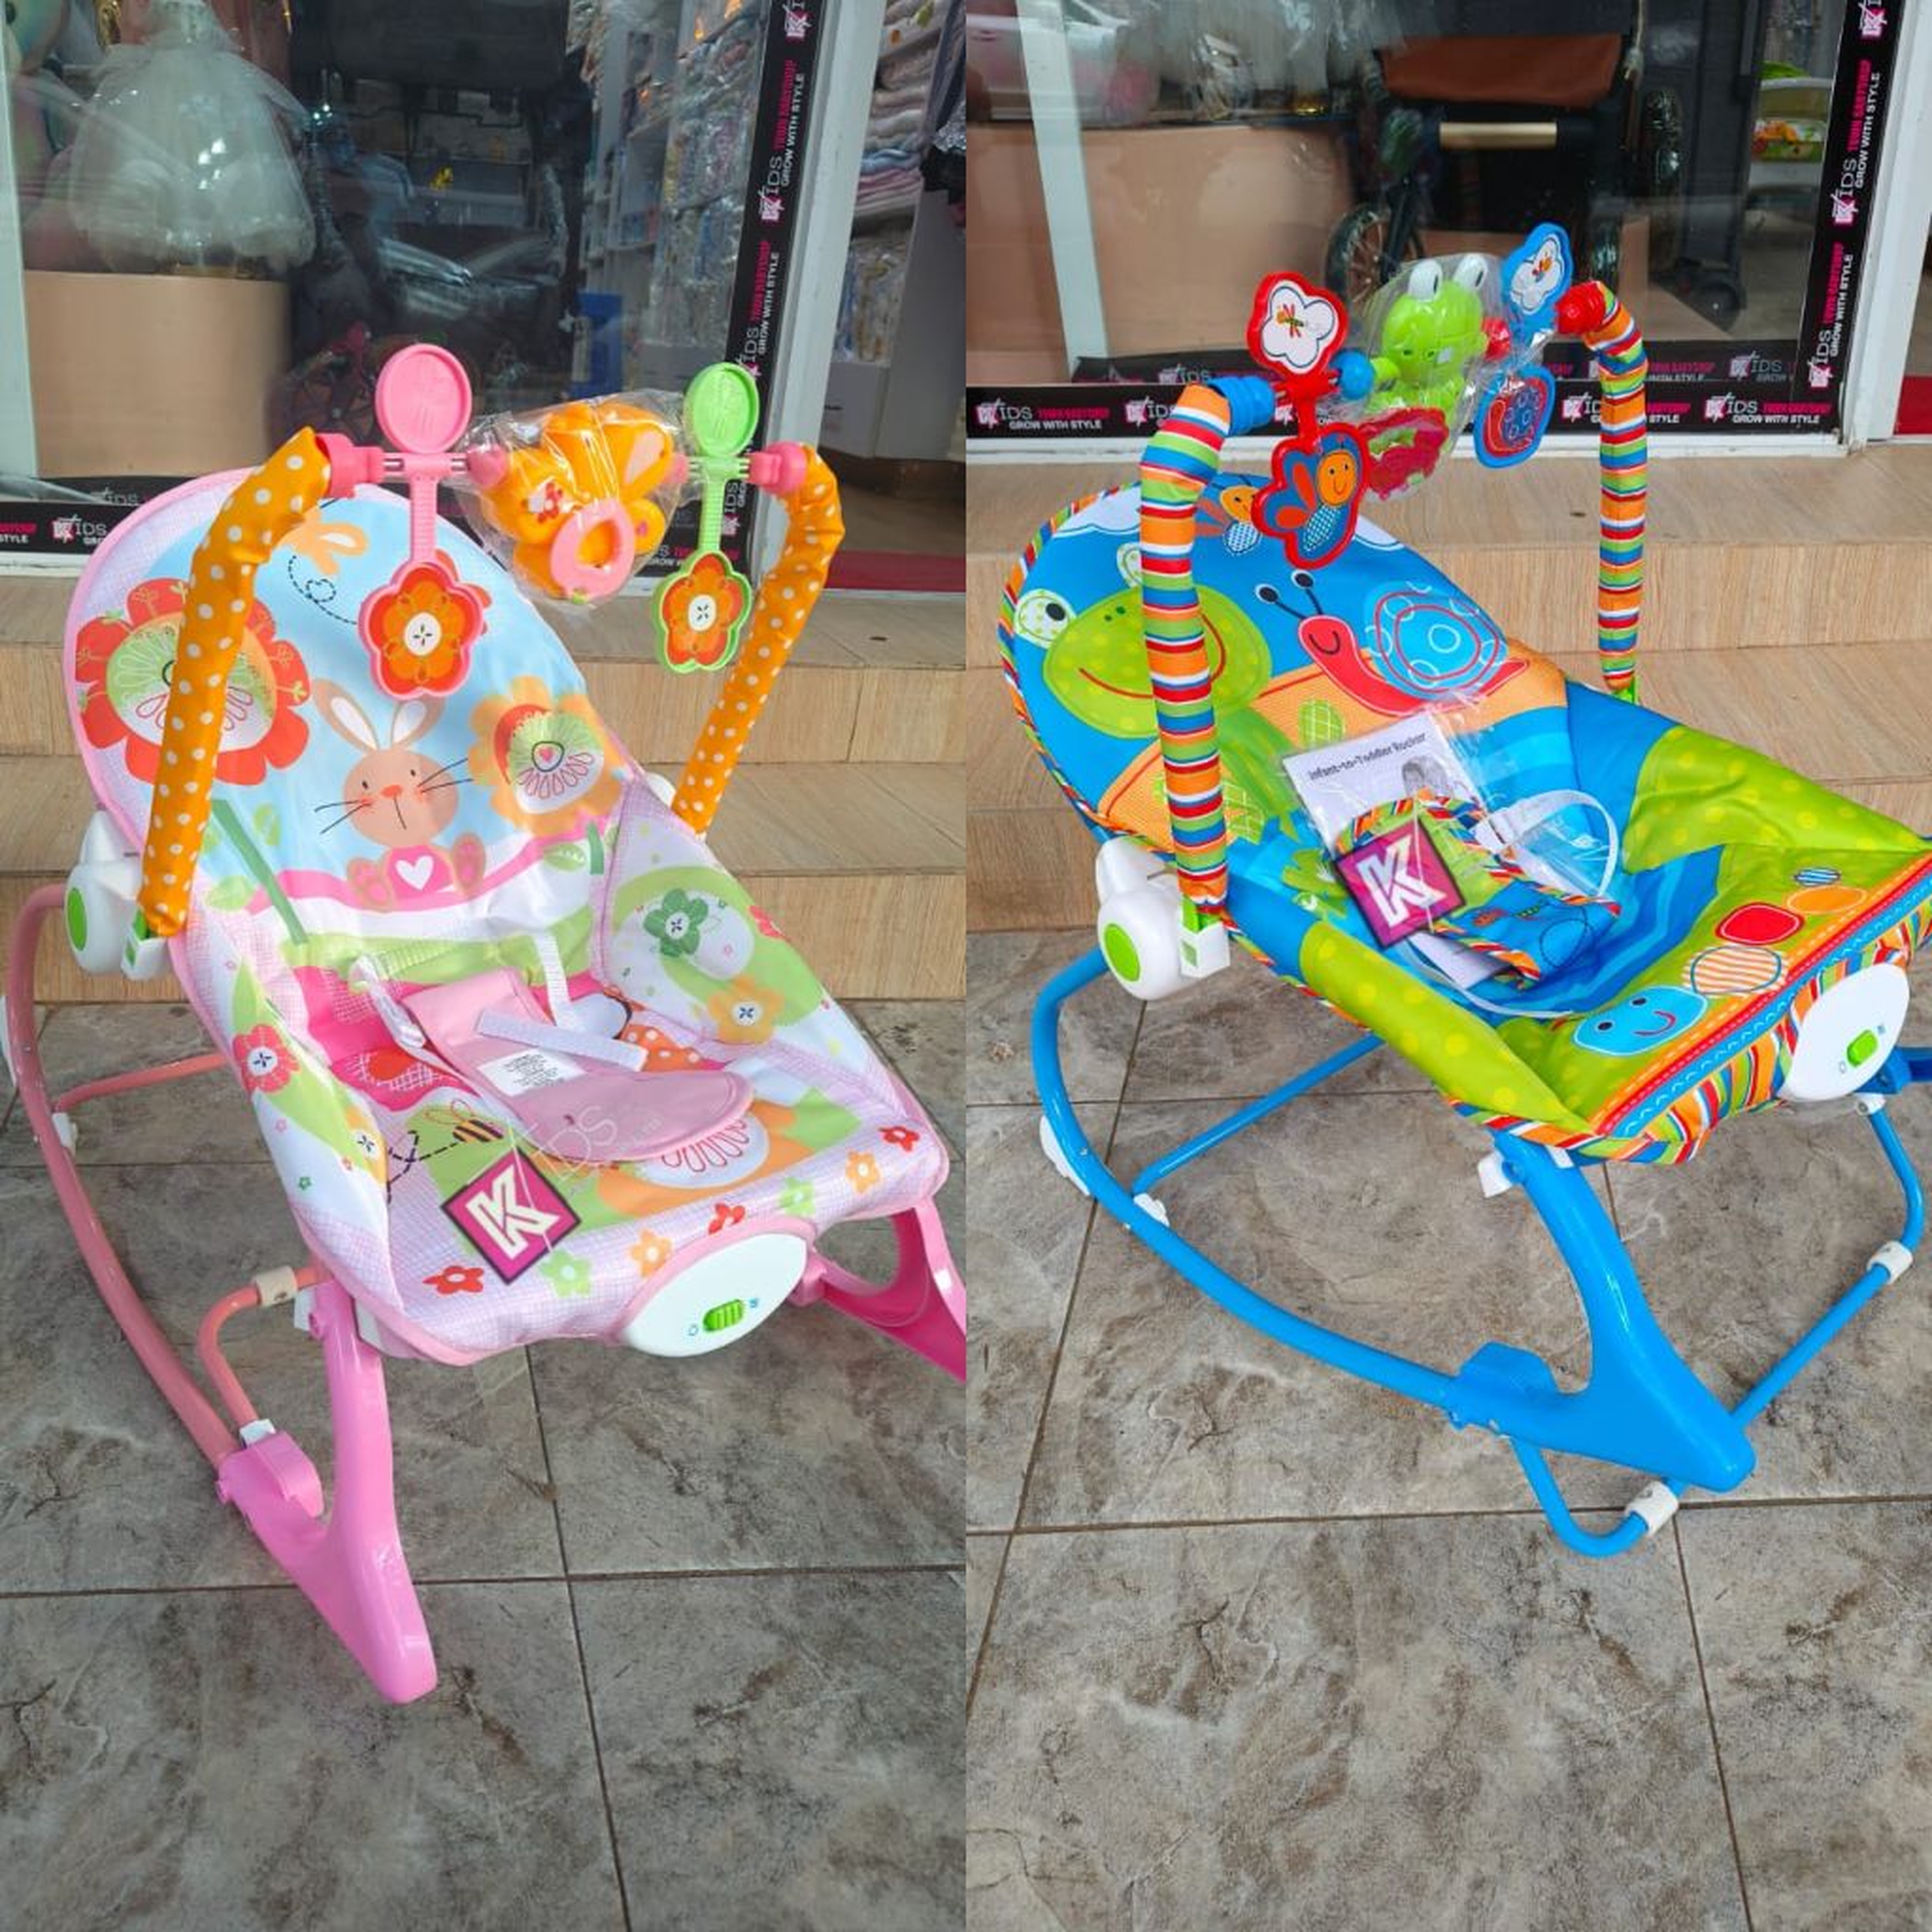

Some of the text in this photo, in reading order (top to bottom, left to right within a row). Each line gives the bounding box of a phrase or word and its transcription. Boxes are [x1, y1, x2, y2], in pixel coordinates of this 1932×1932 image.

[792, 74, 805, 112] STYLE
[787, 115, 798, 147] WITH
[1855, 72, 1880, 188] GROW WITH STYLE
[781, 149, 793, 186] GROW
[1840, 254, 1854, 290] STYLE
[1835, 292, 1847, 321] WITH
[1830, 322, 1843, 357] GROW
[1009, 420, 1103, 429] GROW WITH STYLE
